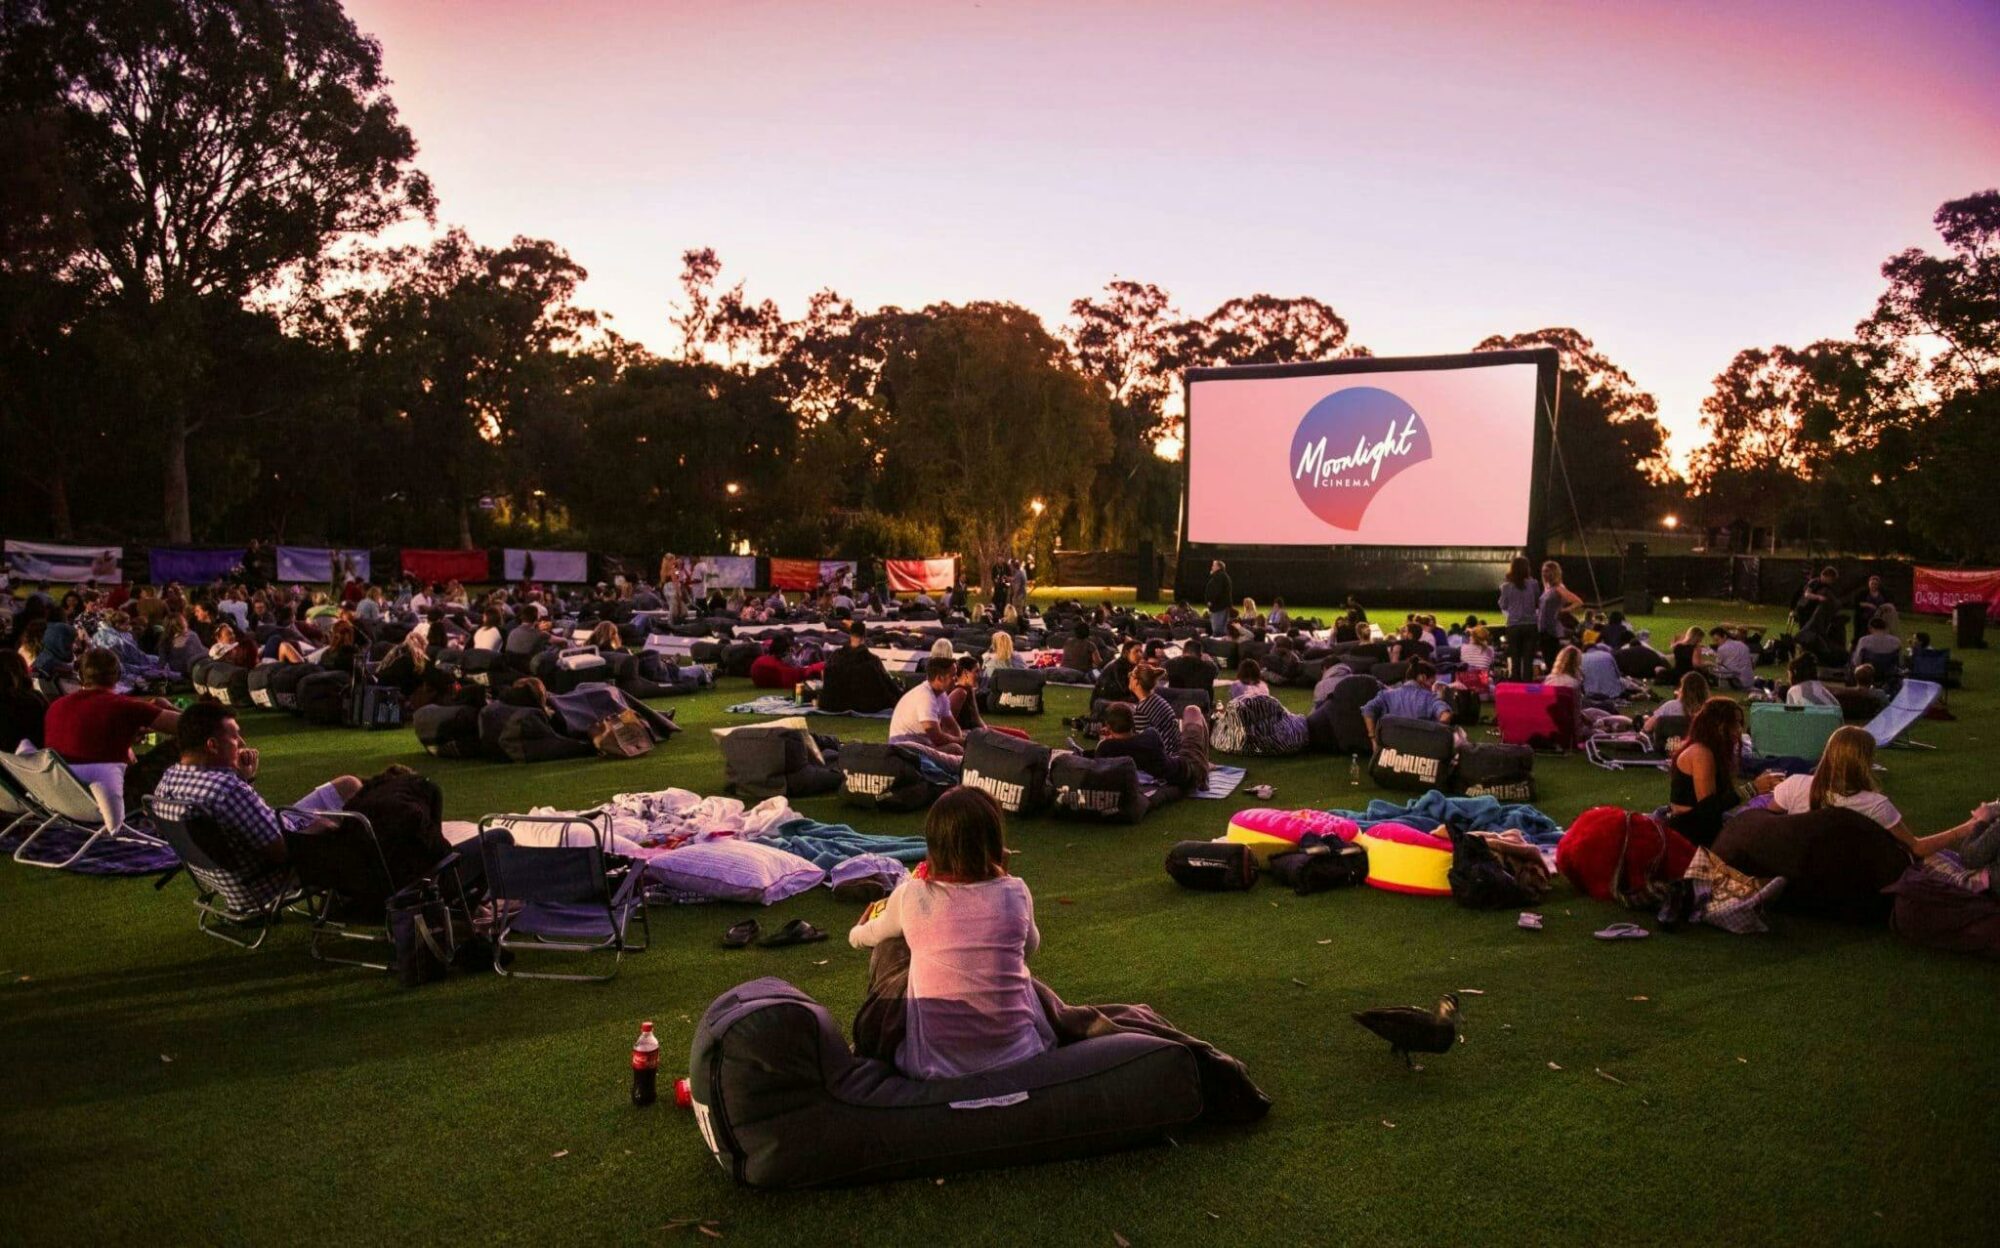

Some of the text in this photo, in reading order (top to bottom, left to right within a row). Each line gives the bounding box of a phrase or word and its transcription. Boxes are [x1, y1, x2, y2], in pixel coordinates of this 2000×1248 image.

[1295, 413, 1417, 488] Moonlight
[1321, 478, 1370, 488] CINEMA
[1378, 748, 1440, 776] MOONLIGHT
[842, 768, 896, 795] ONLIGHT
